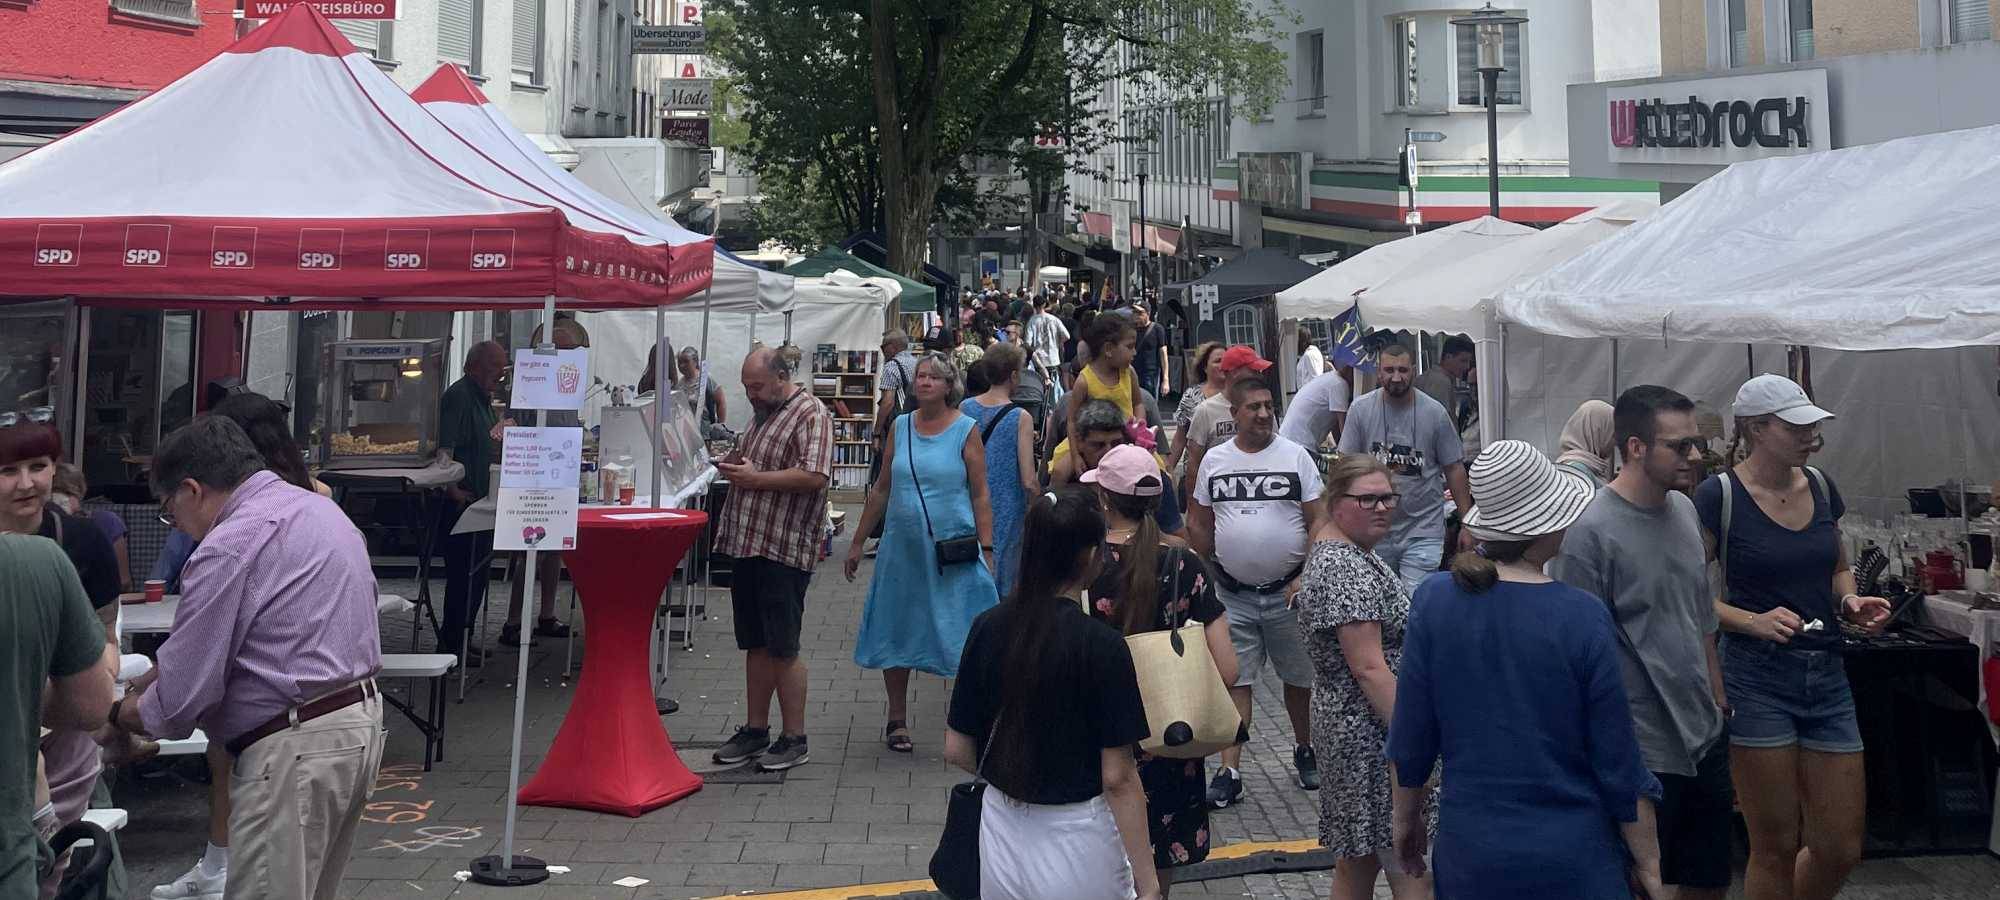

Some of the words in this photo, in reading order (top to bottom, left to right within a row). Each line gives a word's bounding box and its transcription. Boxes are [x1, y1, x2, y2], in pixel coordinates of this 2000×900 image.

[663, 88, 708, 106] Mode
[38, 249, 73, 264] SPD
[126, 249, 161, 264] SPD
[213, 251, 248, 266] SPD
[300, 252, 334, 267] SPD
[387, 253, 421, 268] SPD
[472, 253, 506, 268] SPD
[1212, 474, 1291, 498] NYC
